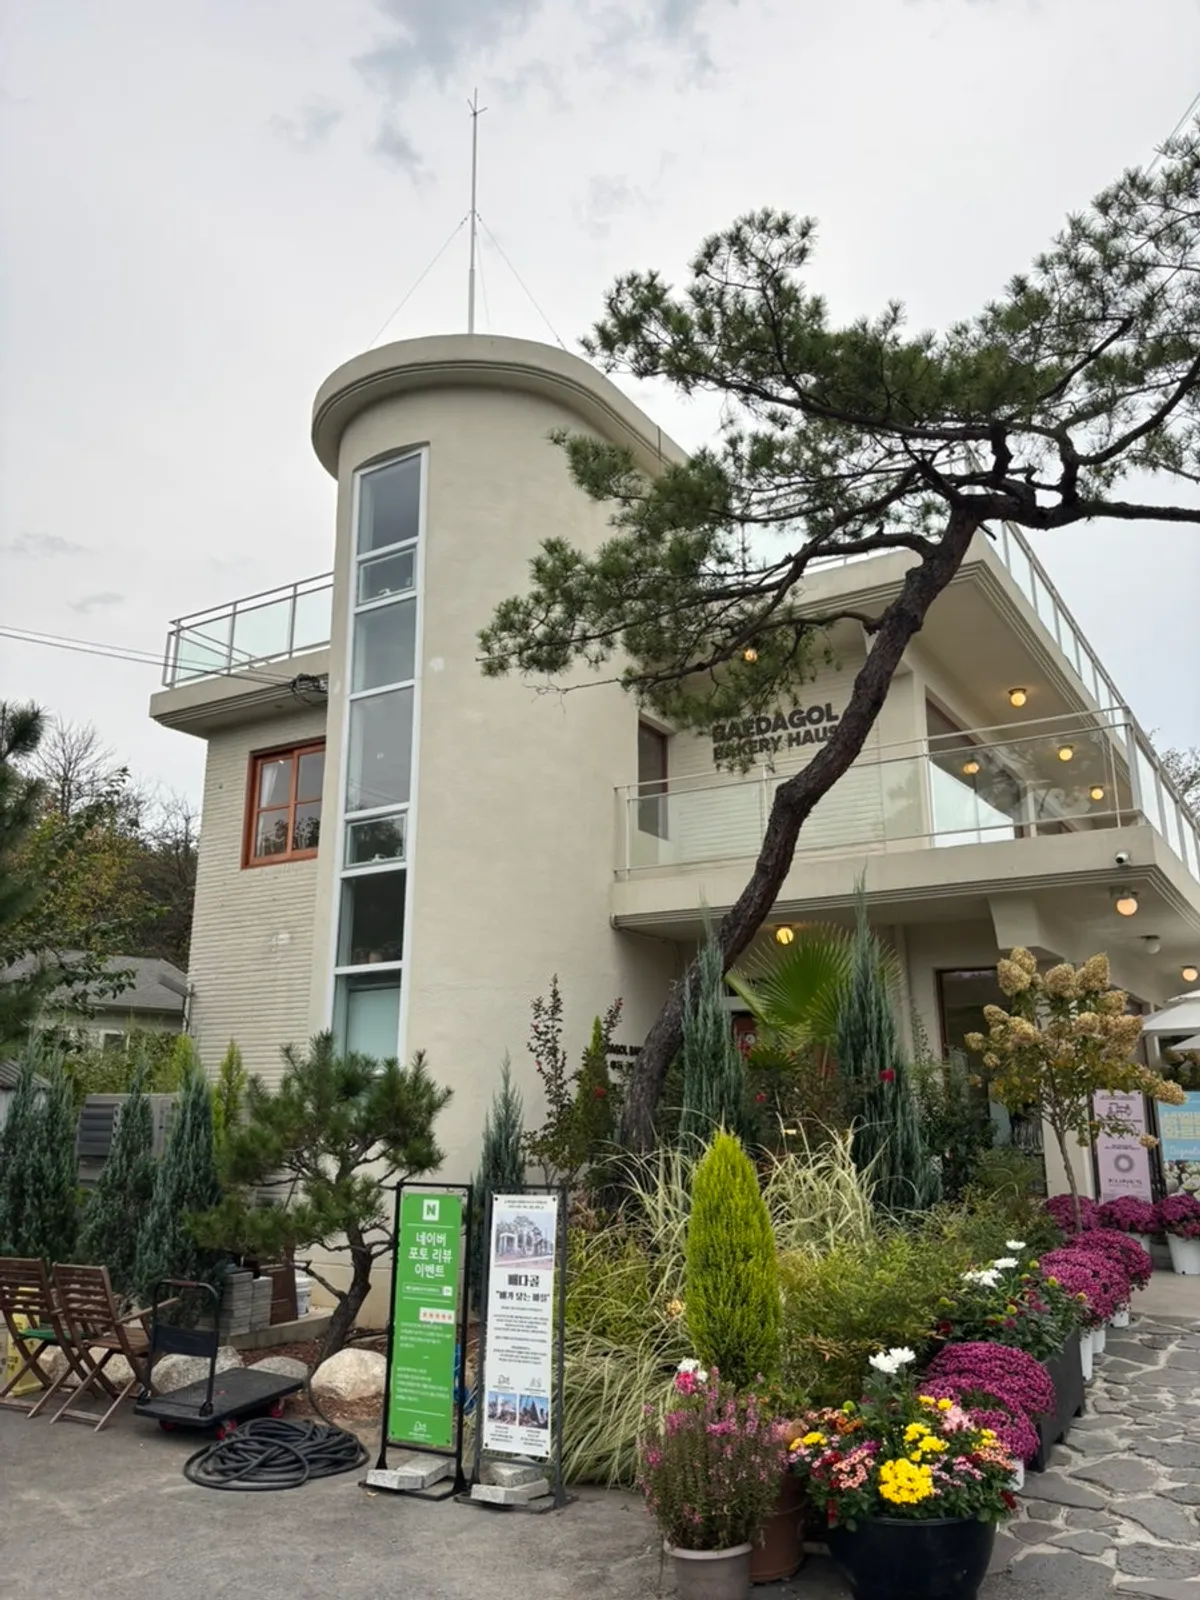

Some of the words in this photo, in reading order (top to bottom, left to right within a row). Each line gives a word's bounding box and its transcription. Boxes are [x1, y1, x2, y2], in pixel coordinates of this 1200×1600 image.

[416, 1231, 447, 1247] 네이버
[408, 1247, 429, 1260] 포토
[432, 1248, 453, 1264] 리뷰
[414, 1263, 446, 1279] 이벤트
